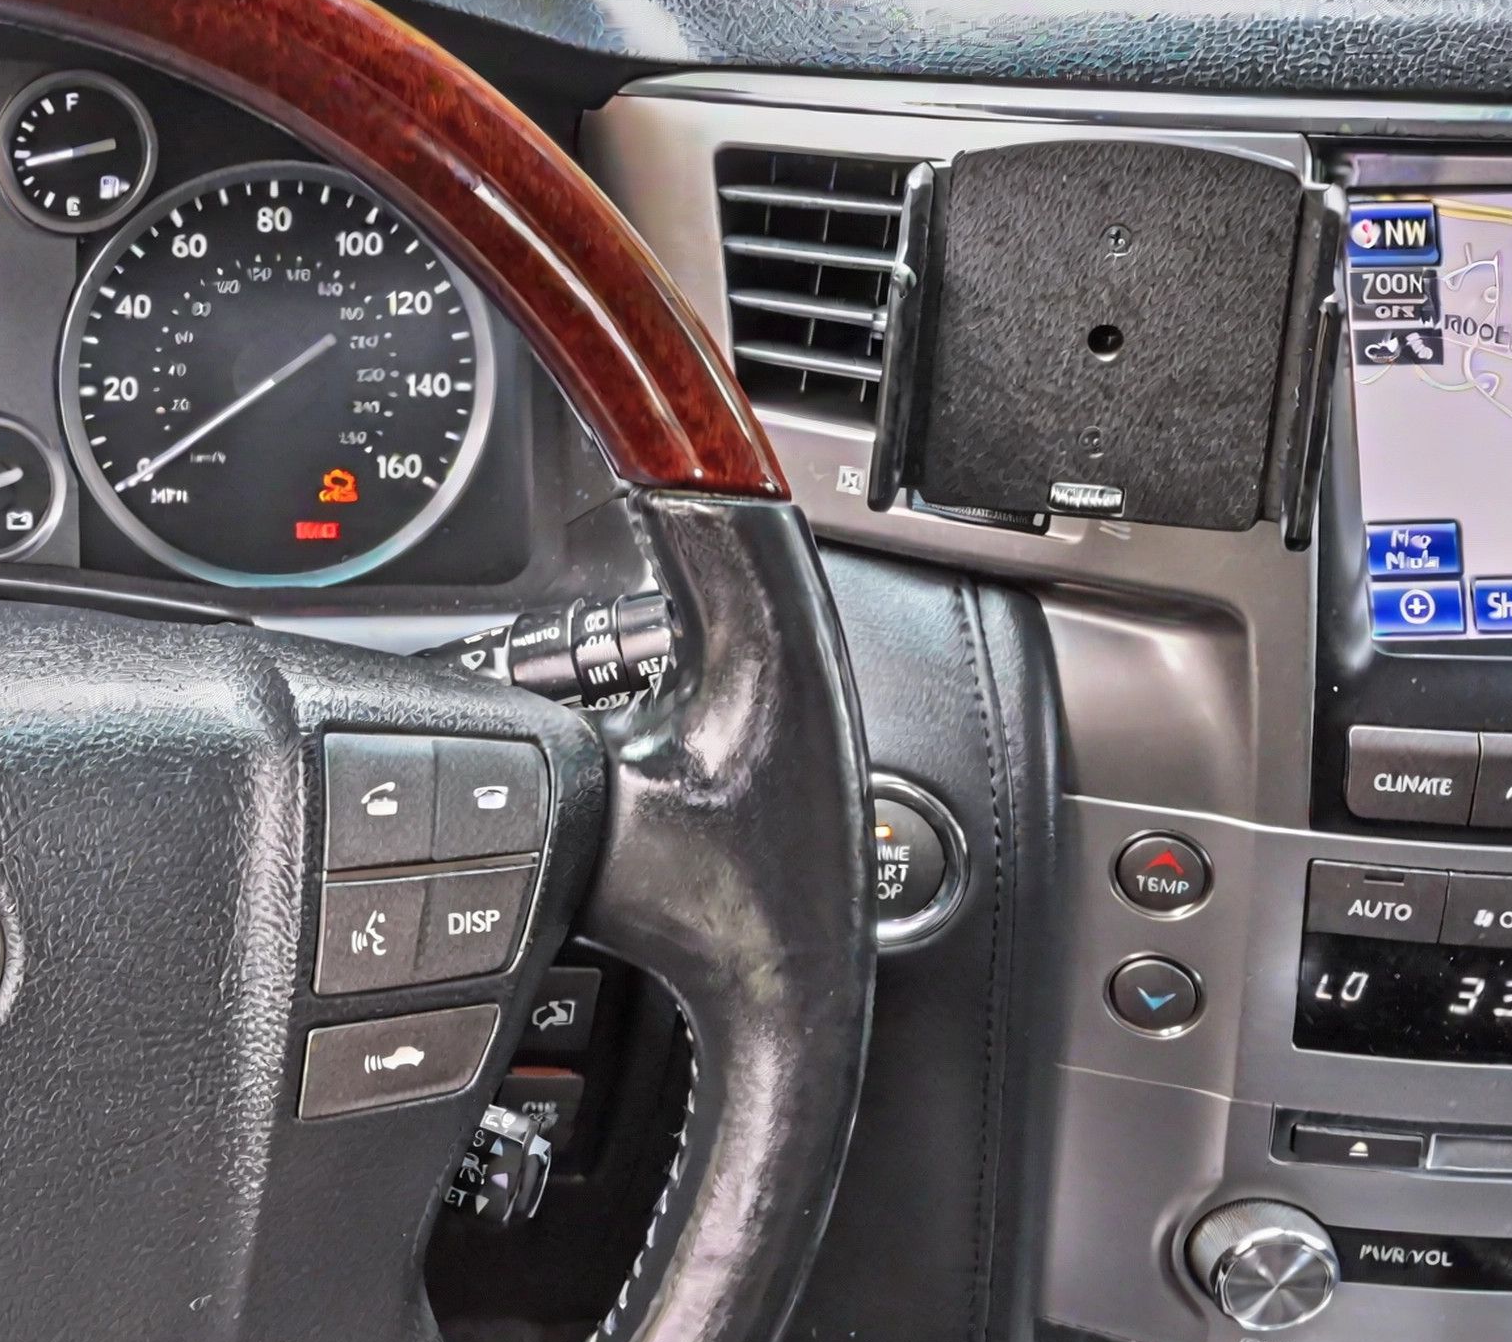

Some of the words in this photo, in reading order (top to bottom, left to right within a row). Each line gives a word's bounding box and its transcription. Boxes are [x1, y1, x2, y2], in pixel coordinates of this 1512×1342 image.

[65, 93, 79, 111] F
[256, 207, 293, 232] 80
[335, 232, 383, 257] 100
[1384, 218, 1427, 247] NW
[172, 233, 208, 259] 60
[115, 293, 152, 320] 40
[387, 290, 433, 315] 120
[103, 376, 139, 401] 20
[406, 372, 452, 398] 140
[376, 454, 422, 480] 160
[1135, 874, 1190, 895] TEMP
[447, 908, 501, 936] DISP
[1346, 899, 1413, 922] AUTO
